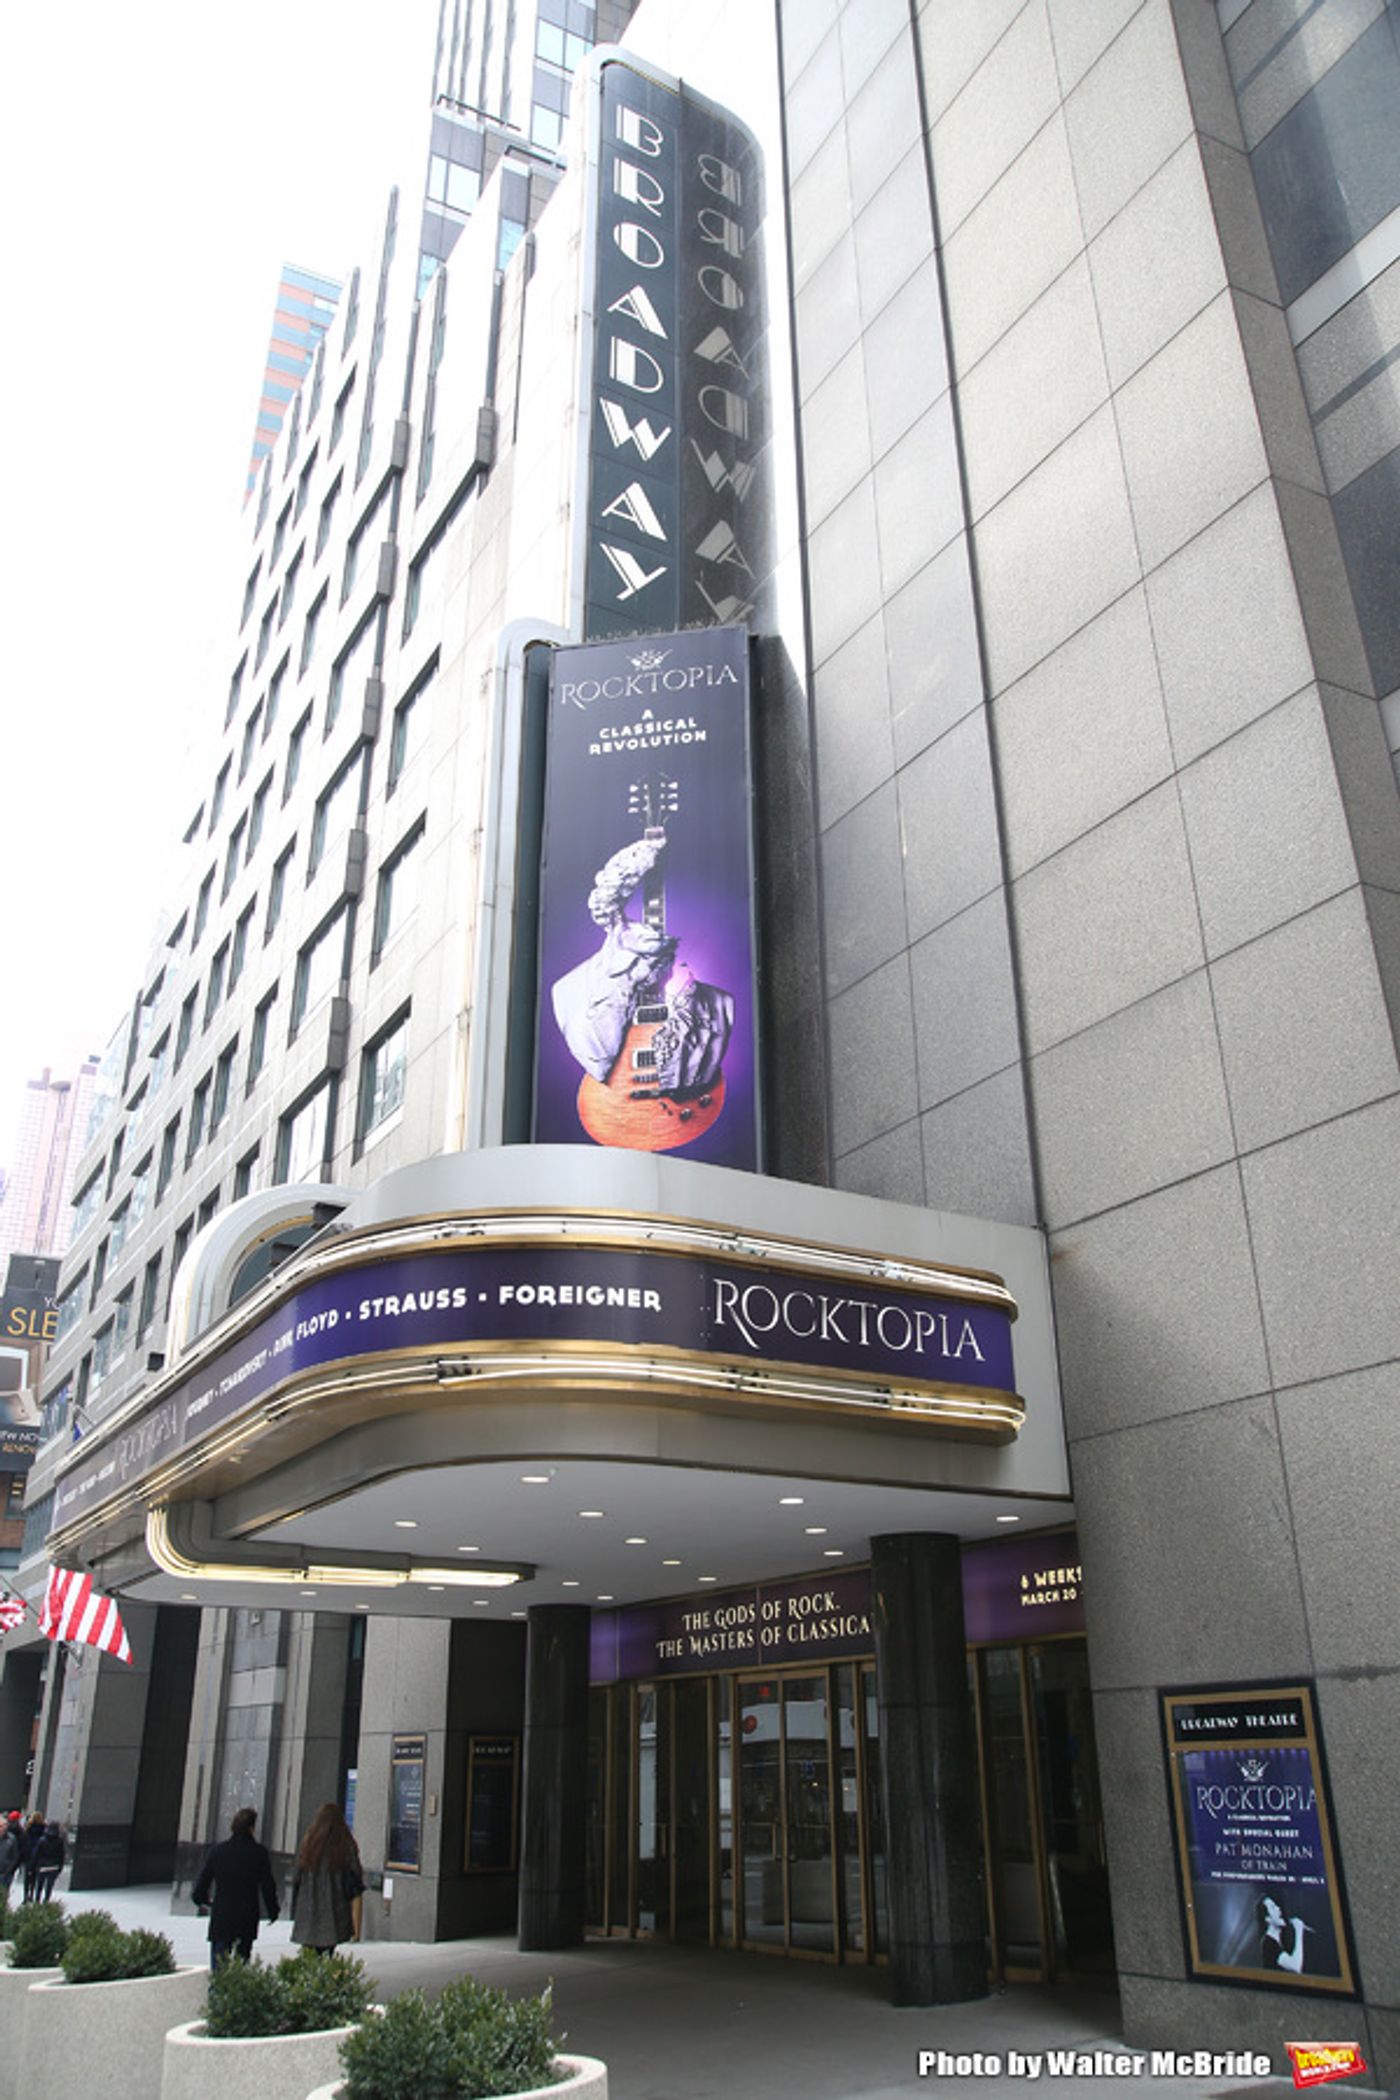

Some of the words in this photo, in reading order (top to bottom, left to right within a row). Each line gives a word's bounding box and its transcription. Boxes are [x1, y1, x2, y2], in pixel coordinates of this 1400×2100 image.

[600, 104, 672, 601] BROADWAY
[560, 664, 740, 711] ROCKTOPIA
[599, 717, 697, 740] CLASSICAL
[641, 708, 654, 720] A
[588, 730, 708, 755] REVOLUTION
[296, 1309, 339, 1341] FLOYD
[359, 1287, 467, 1320] STRAUSS
[498, 1284, 662, 1313] FOREIGNER
[712, 1277, 987, 1362] ROCKTOPIA
[1021, 1589, 1060, 1607] MARCH
[682, 1611, 711, 1632] THE
[714, 1603, 756, 1630] GODS
[761, 1599, 781, 1621] OF
[656, 1637, 683, 1659] THE
[690, 1626, 755, 1658] MASTERS
[760, 1626, 781, 1647] OF
[1196, 1784, 1317, 1820] ROCKTOPIA
[1215, 1841, 1239, 1856] PAT
[1241, 1842, 1314, 1859] MONAHAN
[1257, 1859, 1288, 1872] TRAIN
